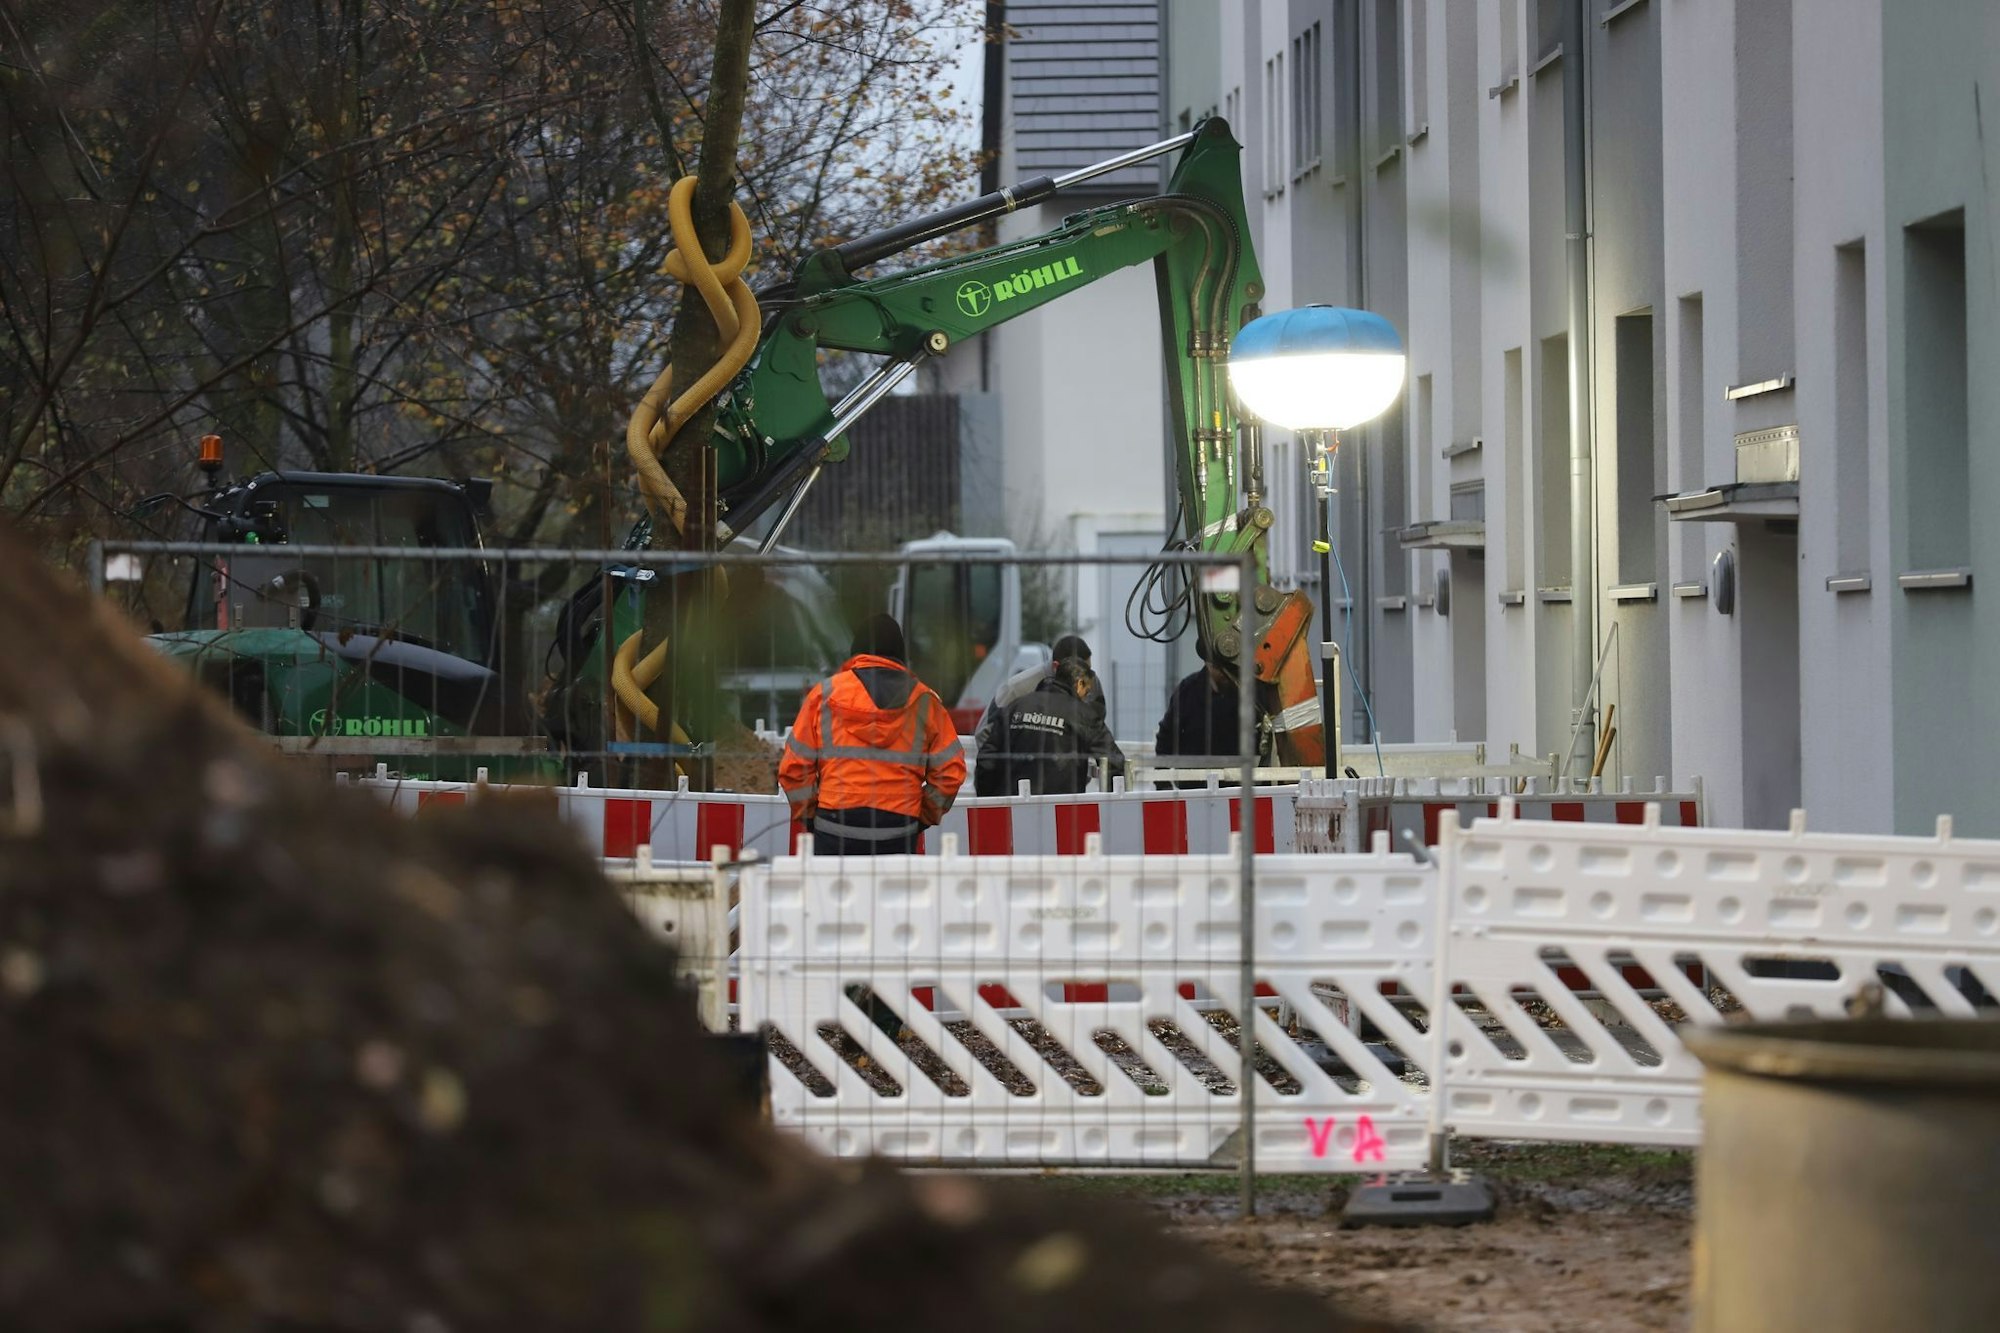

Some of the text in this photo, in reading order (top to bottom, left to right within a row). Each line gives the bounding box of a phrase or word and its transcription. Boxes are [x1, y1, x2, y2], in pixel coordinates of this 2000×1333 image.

[993, 256, 1084, 302] RÖHLL
[345, 715, 428, 737] RÖHLL
[1022, 712, 1065, 729] RÖHLL
